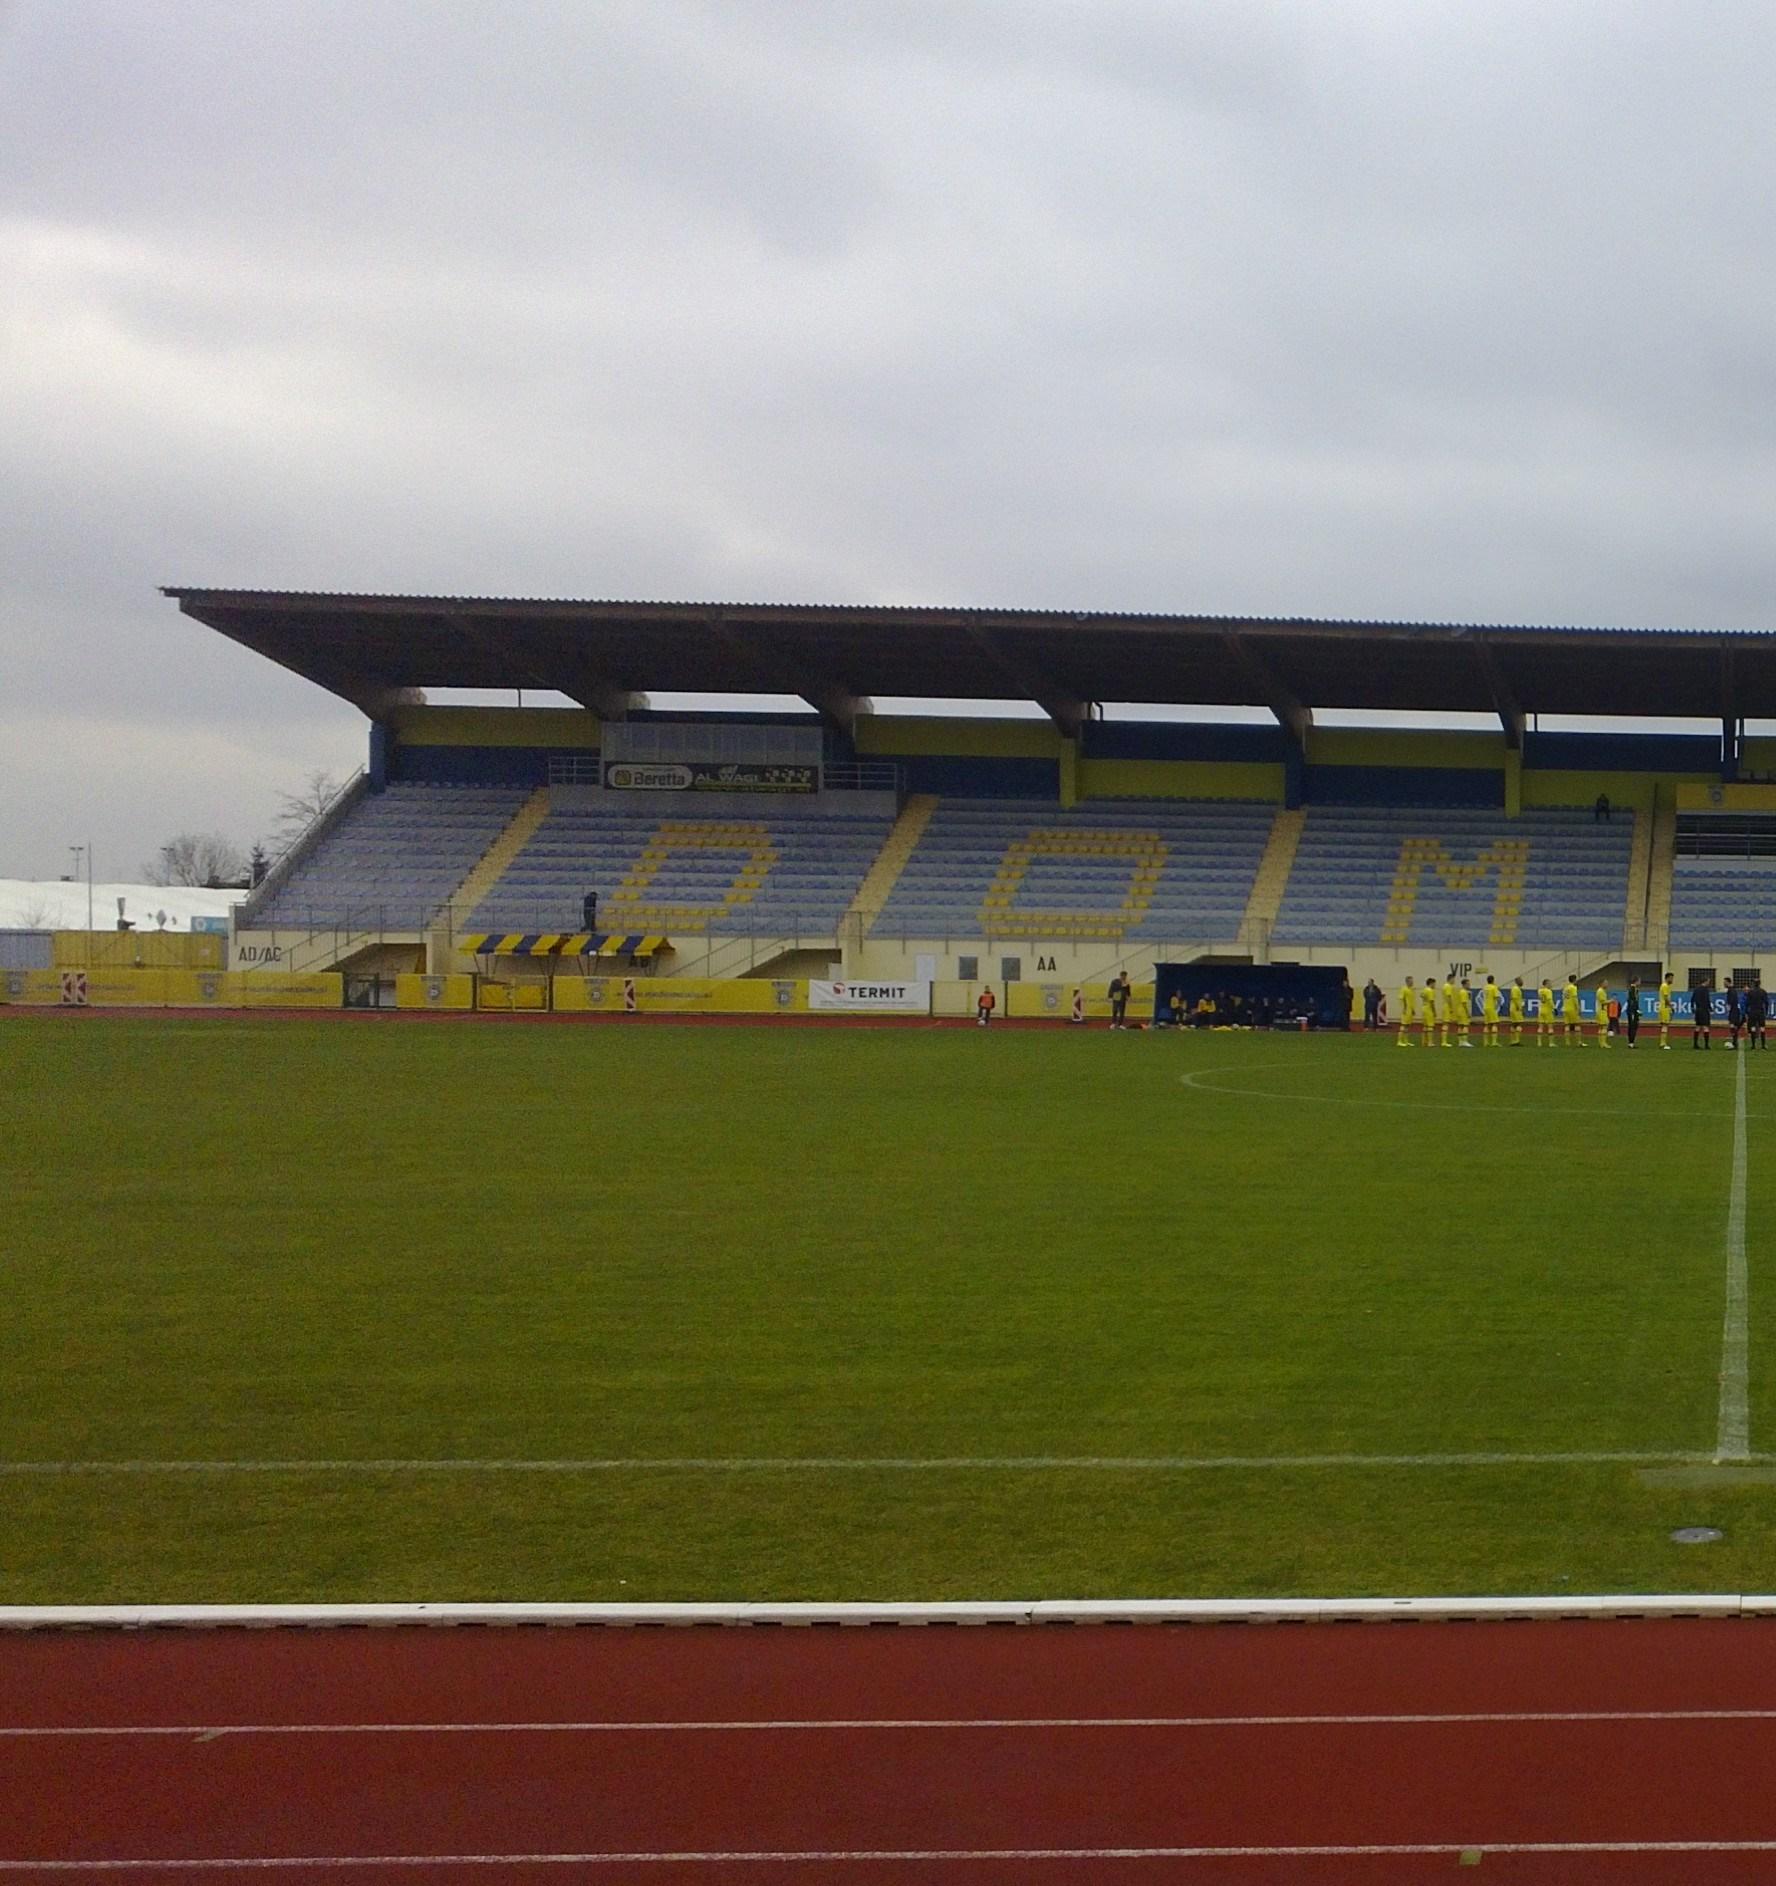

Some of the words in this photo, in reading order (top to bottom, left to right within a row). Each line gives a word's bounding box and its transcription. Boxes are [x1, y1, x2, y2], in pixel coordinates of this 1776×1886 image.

[634, 771, 685, 786] Beretta
[1036, 956, 1057, 972] AA
[1449, 962, 1473, 977] VIP
[847, 986, 906, 999] TERMIT
